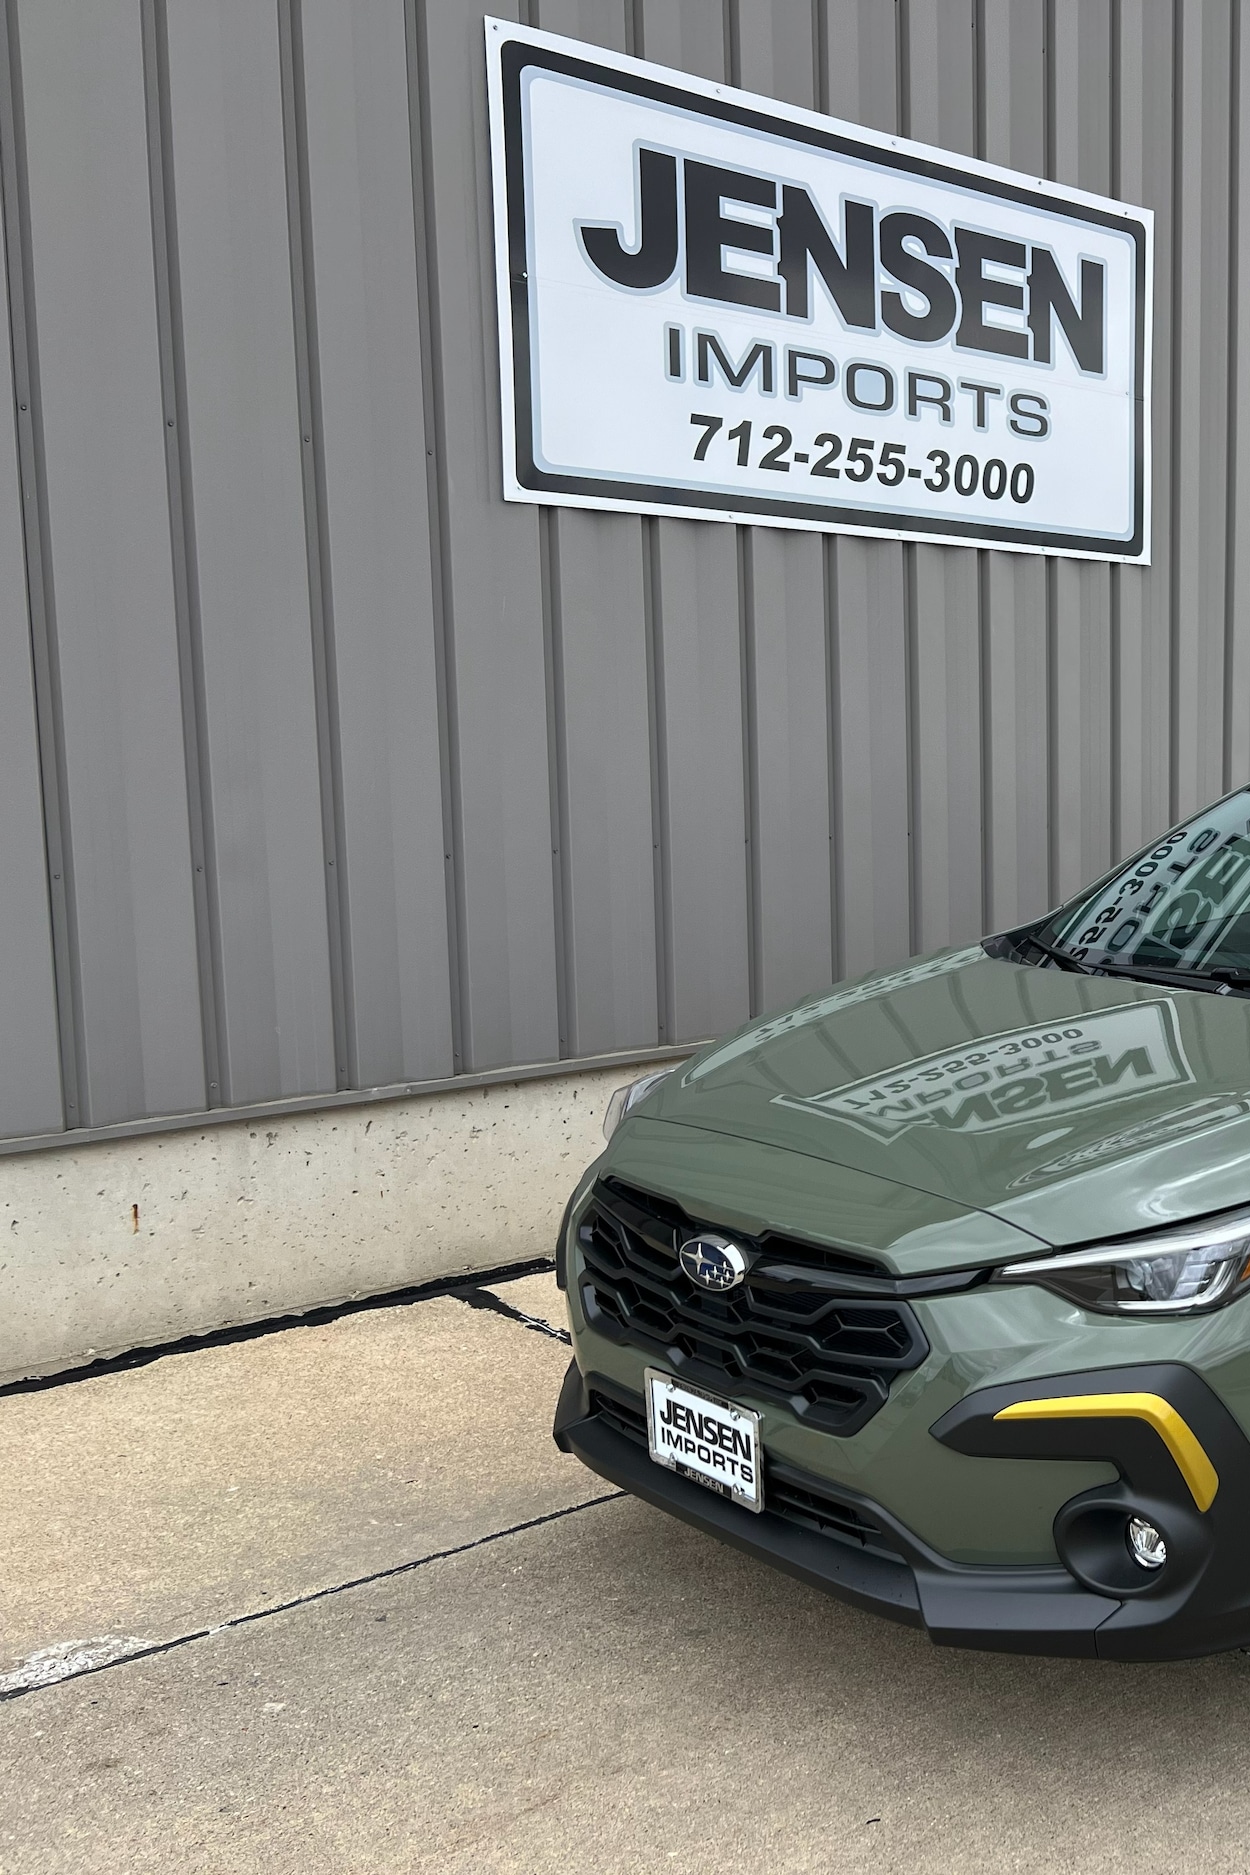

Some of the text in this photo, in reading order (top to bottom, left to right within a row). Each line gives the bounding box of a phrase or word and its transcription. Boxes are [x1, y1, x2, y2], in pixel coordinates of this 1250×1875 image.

[579, 147, 1105, 375] JENSEN
[669, 326, 1050, 438] IMPORTS
[689, 414, 1036, 504] 712-255-3000
[659, 1398, 752, 1462] JENSEN
[661, 1427, 754, 1484] IMPORTS
[684, 1467, 724, 1493] JENSEN
